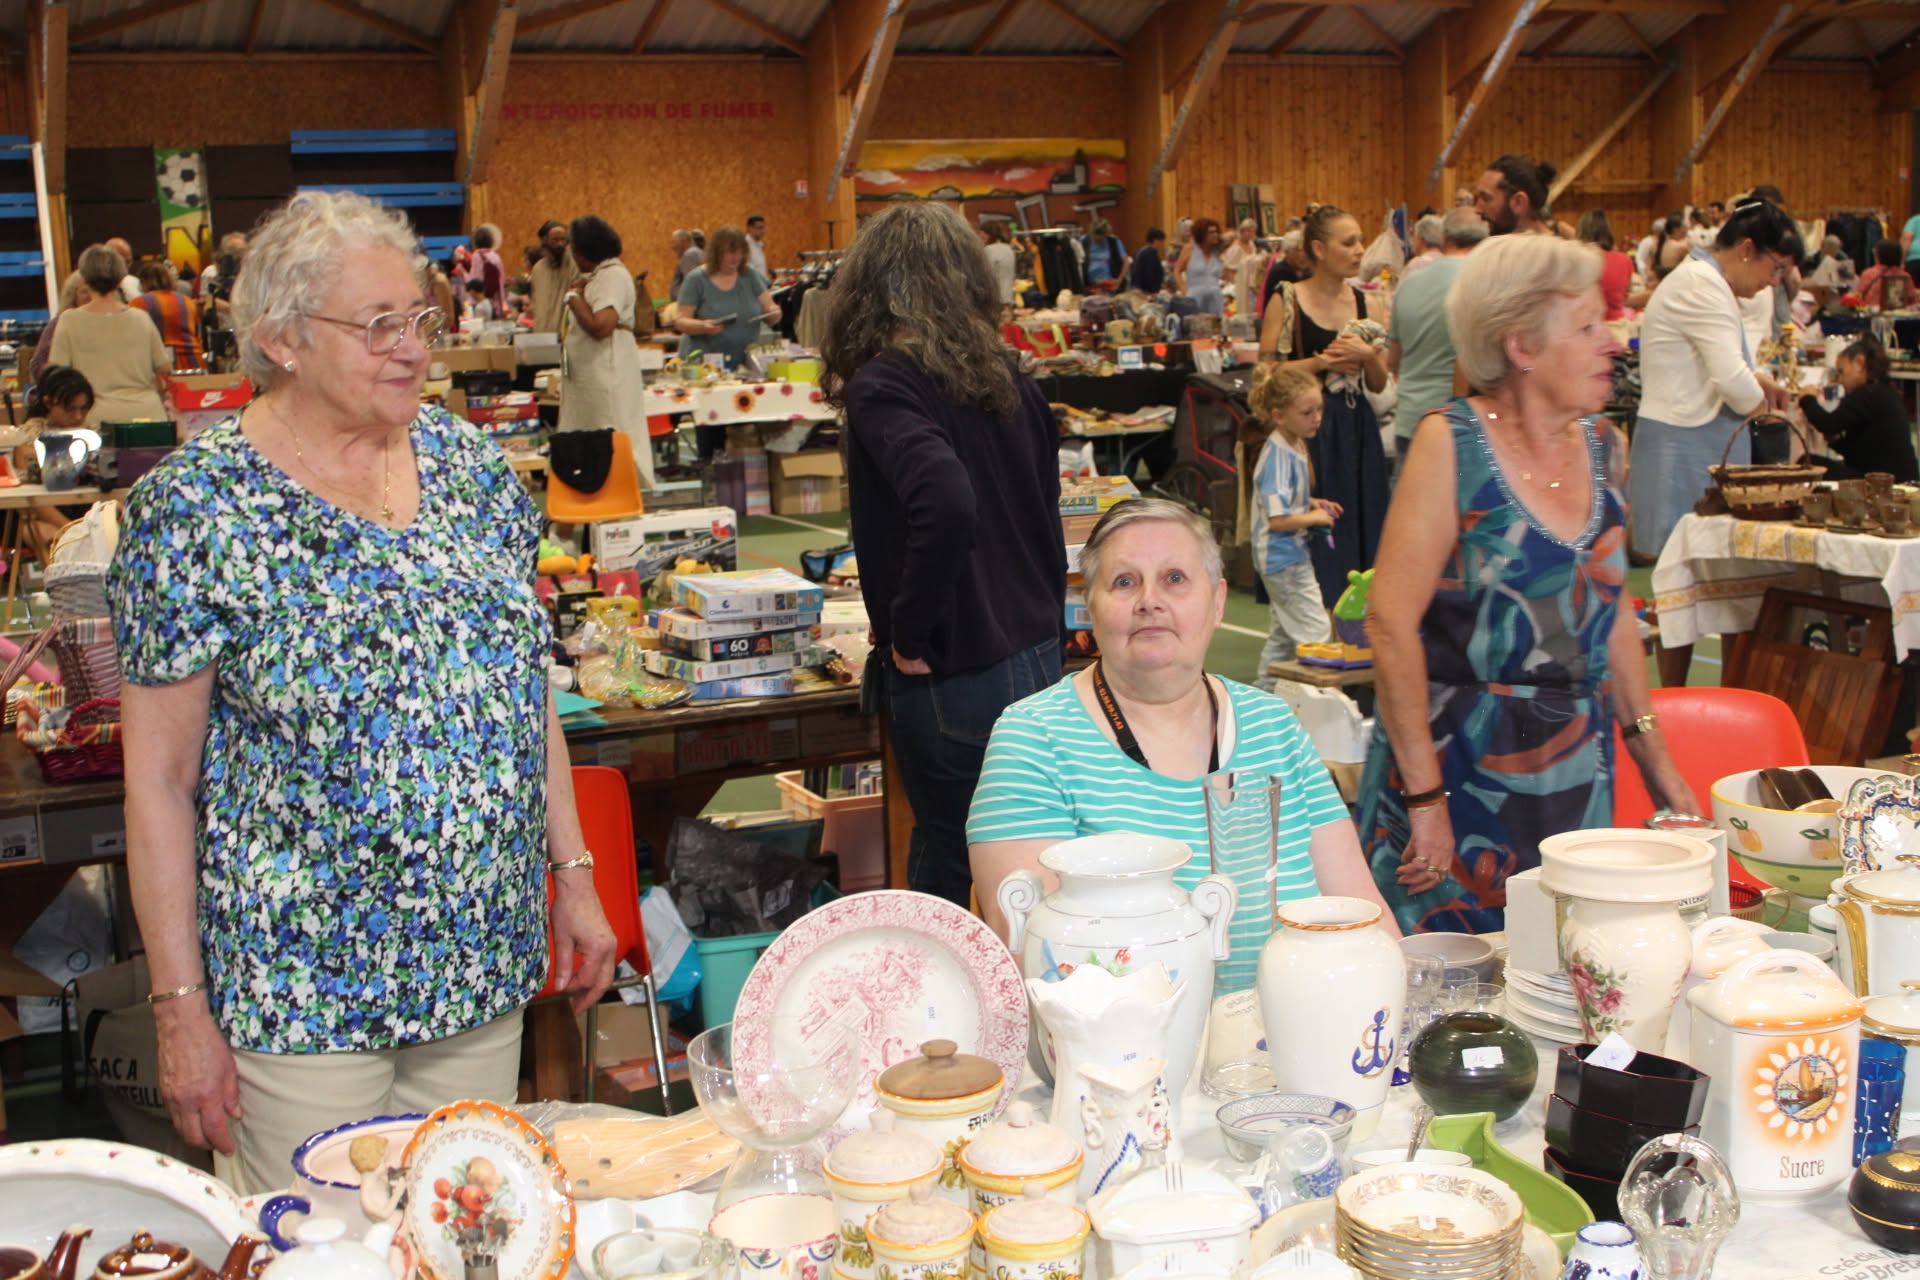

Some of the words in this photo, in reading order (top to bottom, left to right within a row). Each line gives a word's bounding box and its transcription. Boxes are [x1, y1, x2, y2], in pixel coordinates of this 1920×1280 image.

[500, 103, 657, 119] NTERDICTION
[665, 103, 692, 118] DE
[702, 103, 775, 118] FUMER
[730, 639, 749, 652] 60
[1779, 1156, 1825, 1179] Sucre
[911, 1259, 955, 1273] POIVRE
[1037, 1261, 1065, 1274] SEL
